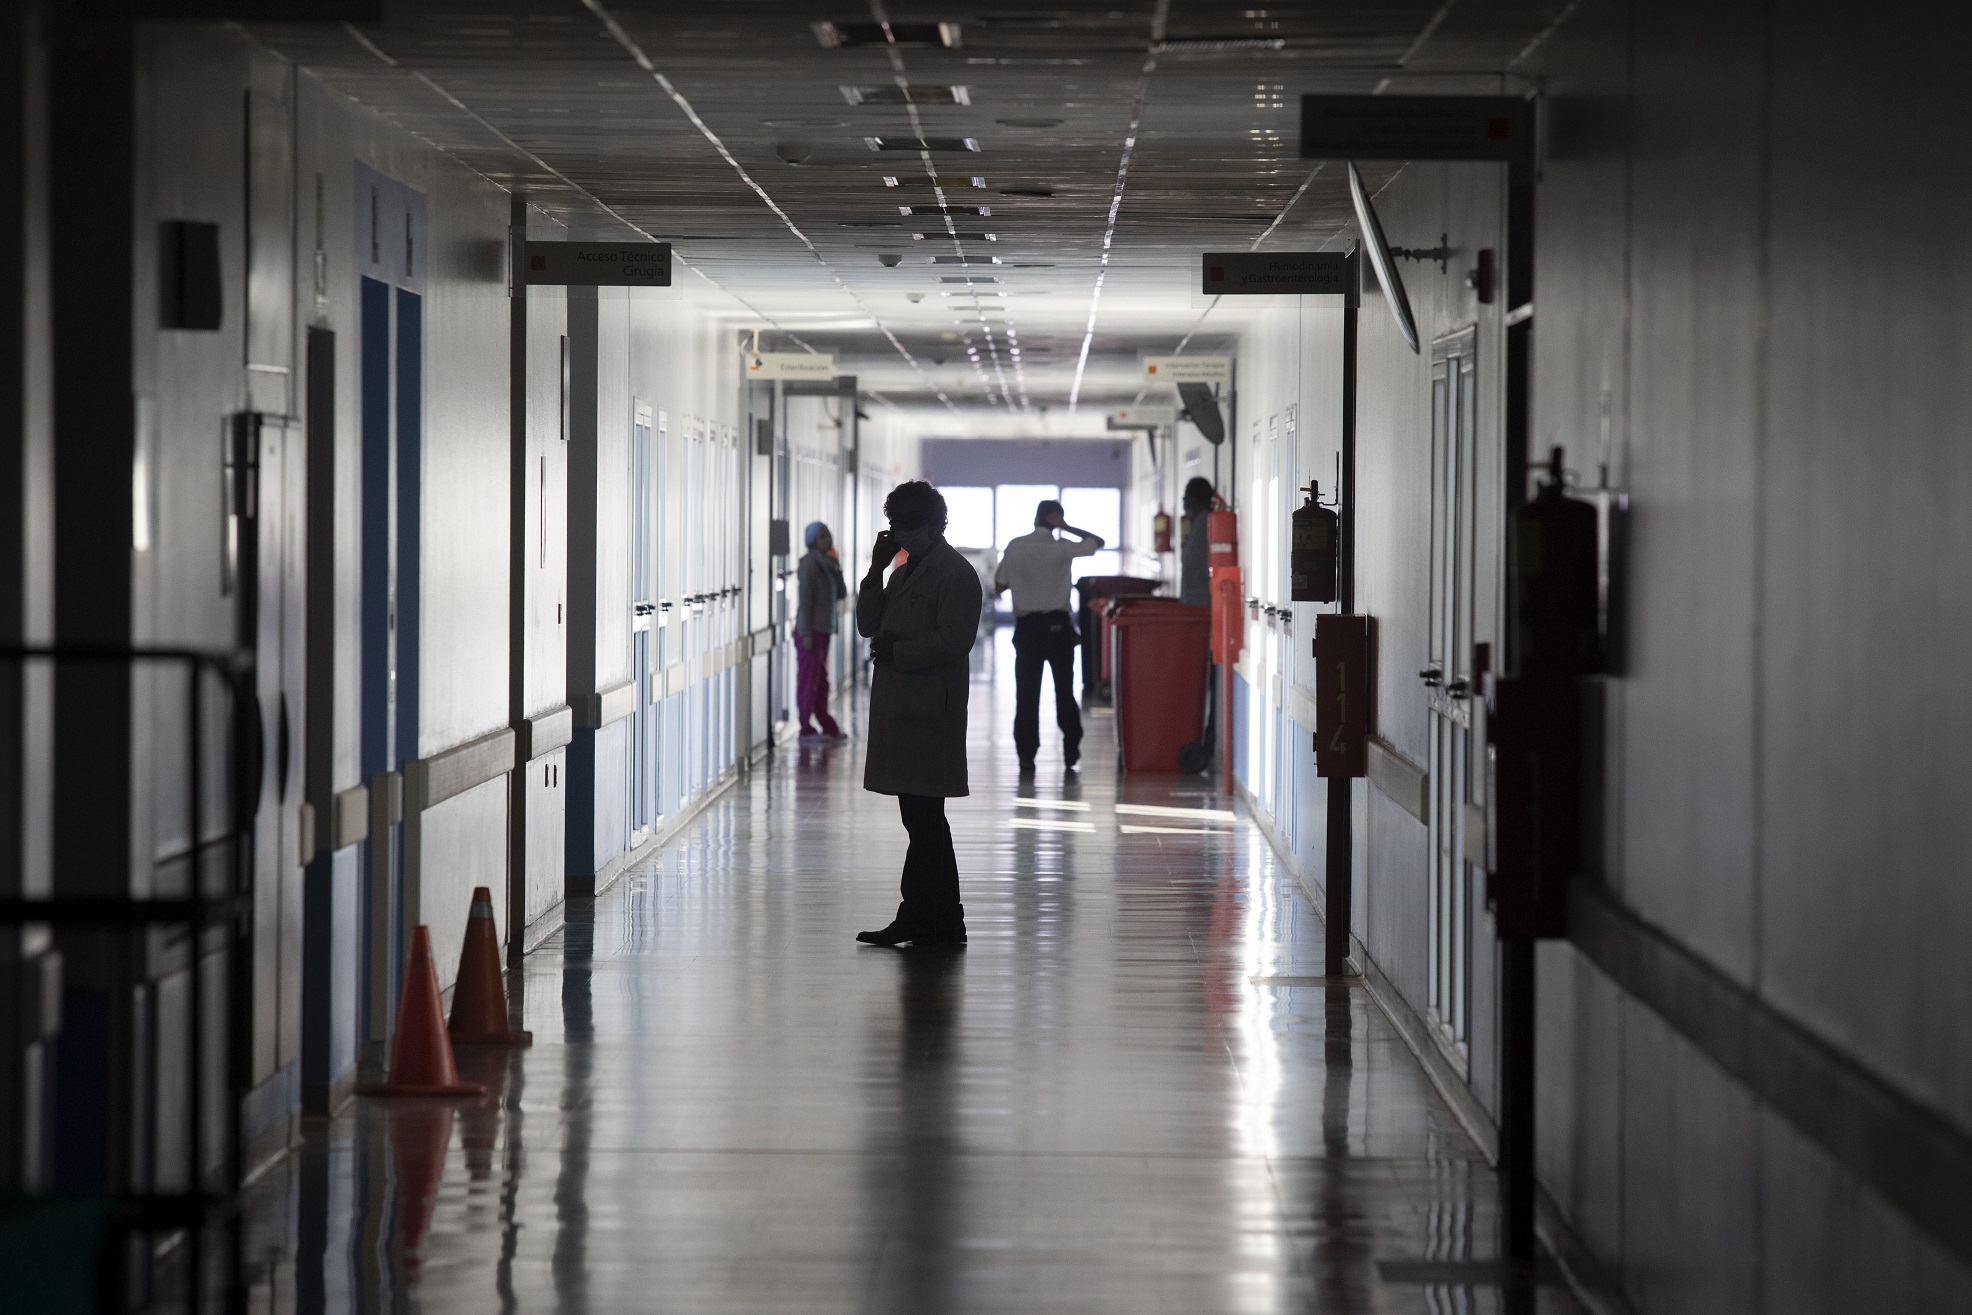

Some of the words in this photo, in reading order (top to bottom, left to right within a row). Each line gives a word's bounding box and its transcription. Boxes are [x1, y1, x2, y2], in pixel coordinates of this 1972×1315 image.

[576, 250, 618, 262] Acceso
[620, 250, 665, 262] Técnico
[623, 264, 665, 279] Cirugía
[1268, 260, 1339, 271] Hemodinamia
[1241, 275, 1247, 285] y
[1248, 272, 1339, 285] Gastroenterología
